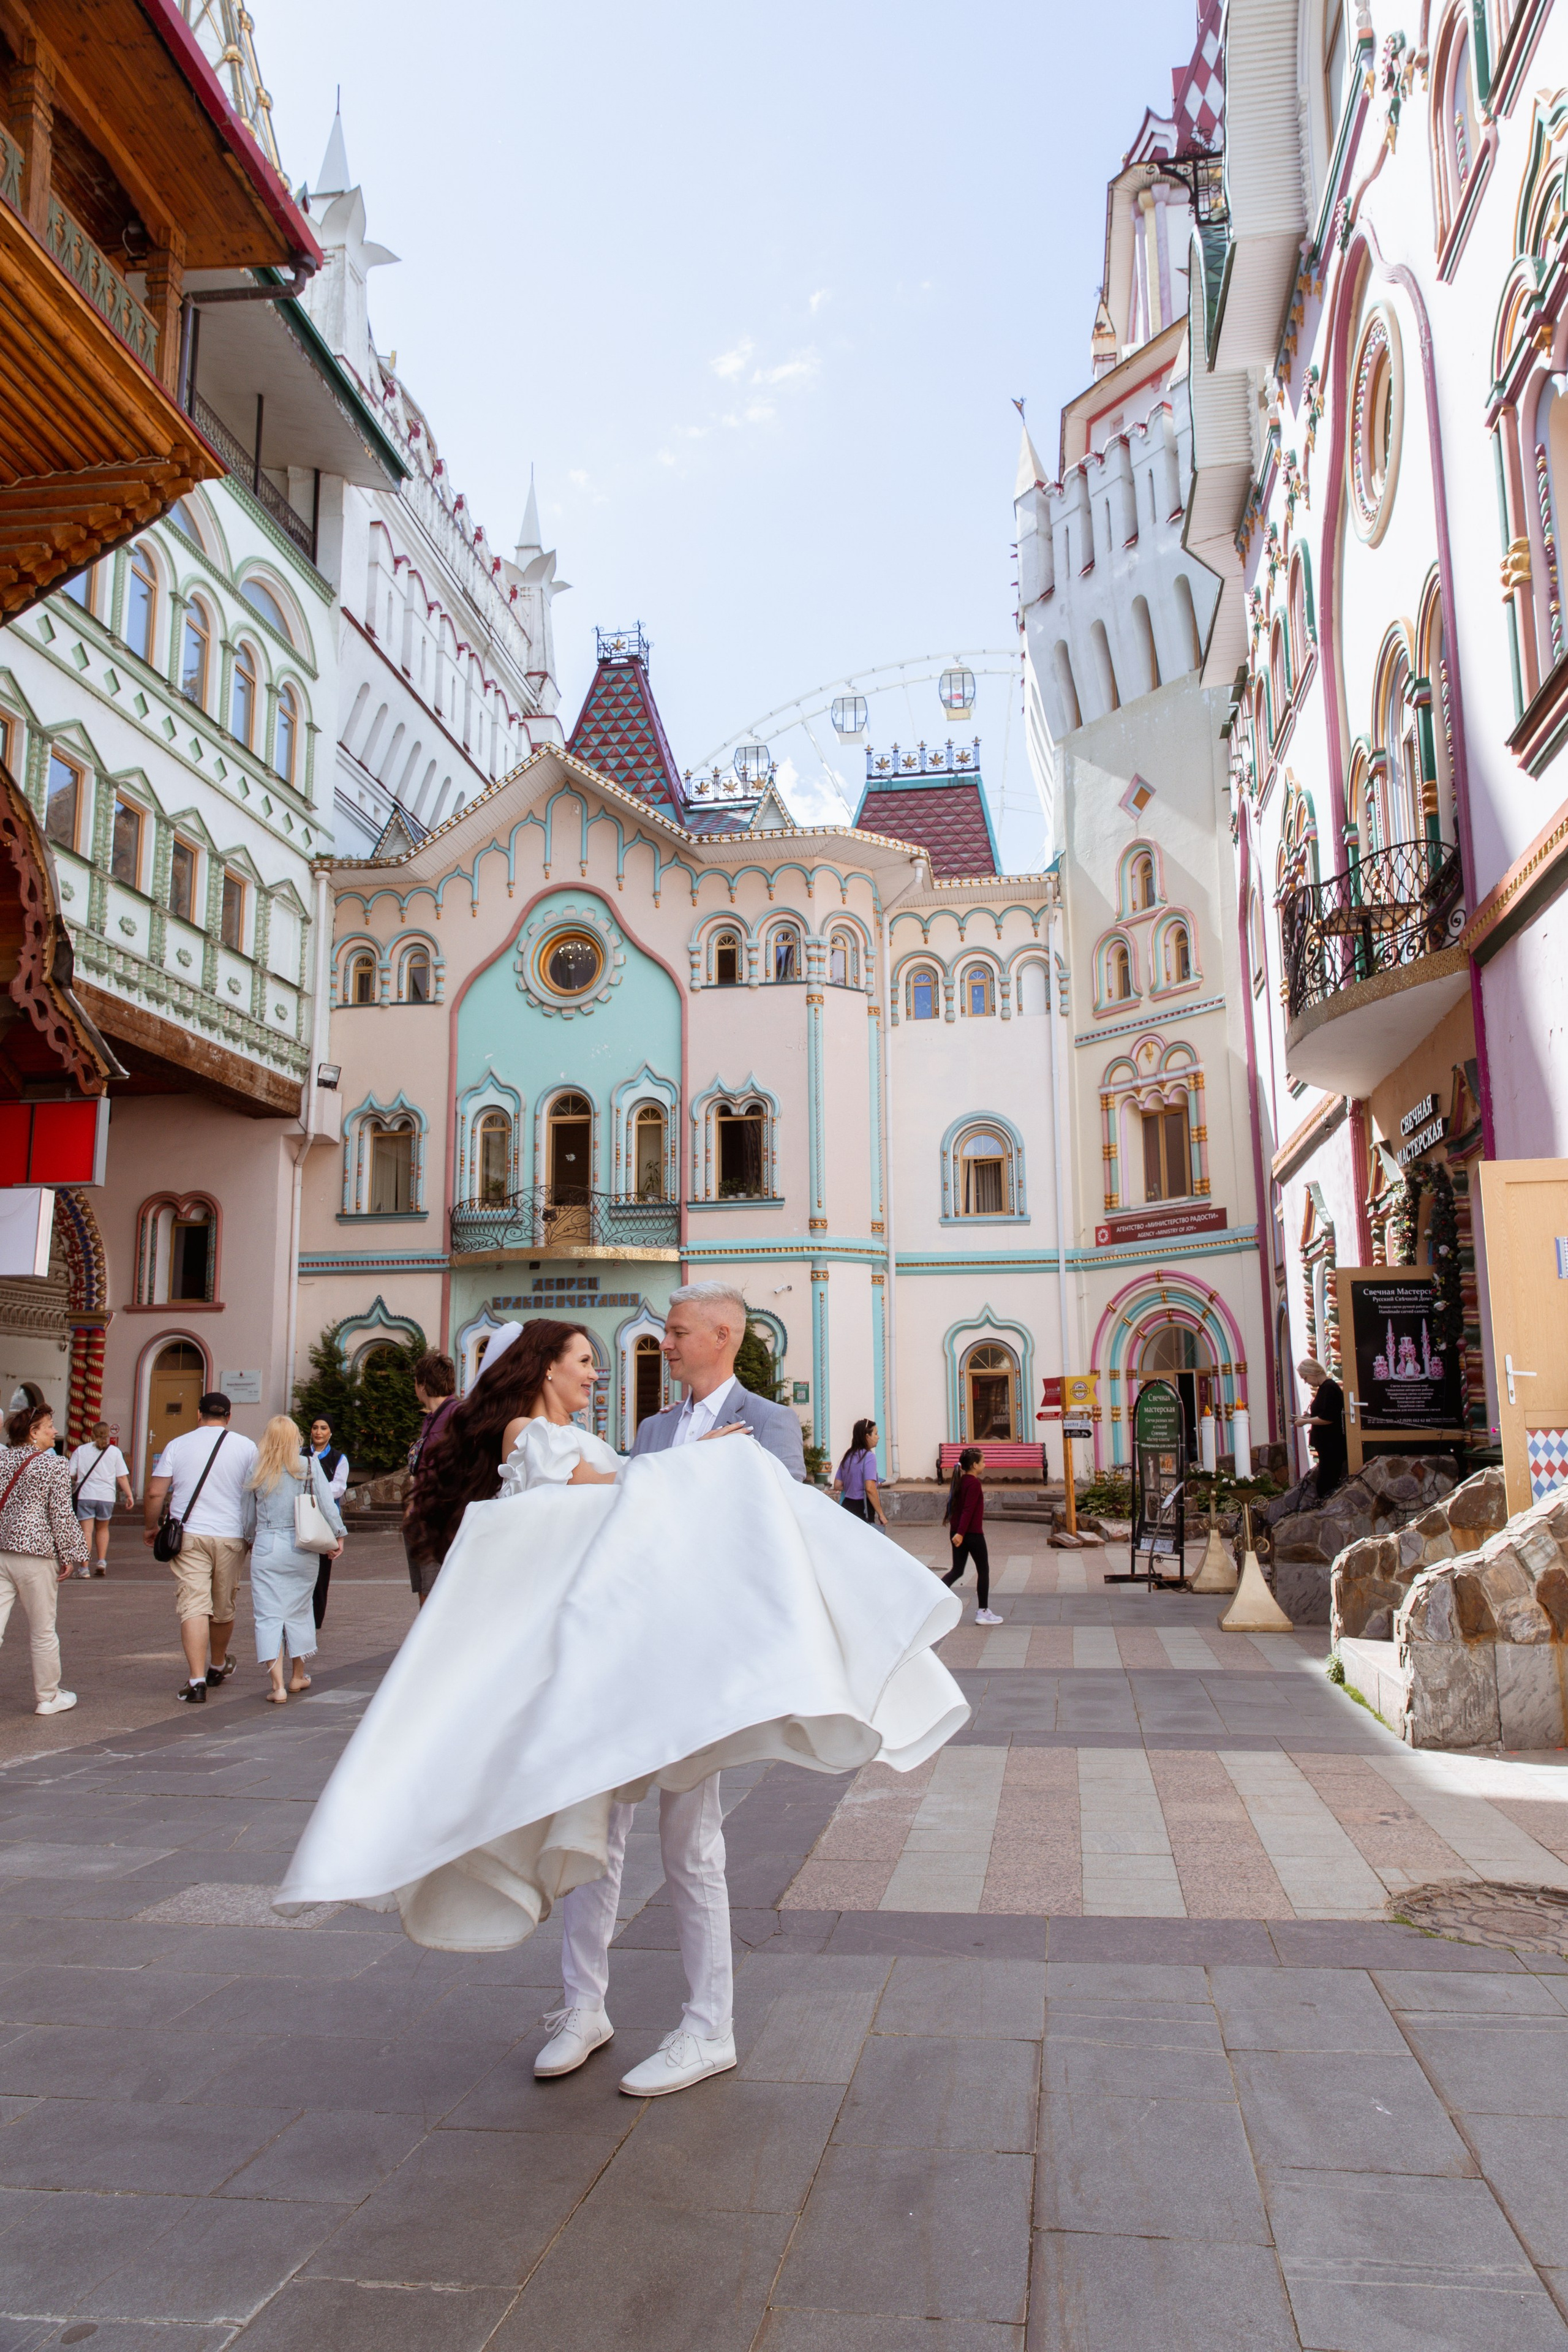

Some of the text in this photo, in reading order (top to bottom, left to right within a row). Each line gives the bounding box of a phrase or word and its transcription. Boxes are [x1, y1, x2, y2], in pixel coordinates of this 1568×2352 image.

[1400, 1094, 1433, 1136] СВЕЧНАЯ
[1396, 1117, 1444, 1169] МАСТЕРСКАЯ
[1116, 1213, 1219, 1232] АГЕНТСТВО «МИНИСТЕРСТВО РАДОСТИ»
[532, 1277, 600, 1292] ДВОРЕЦ
[1396, 1287, 1432, 1296] Мастерск
[492, 1293, 641, 1310] БРАКОСОЧЕТАНИЯ
[1144, 1406, 1175, 1415] мастерская
